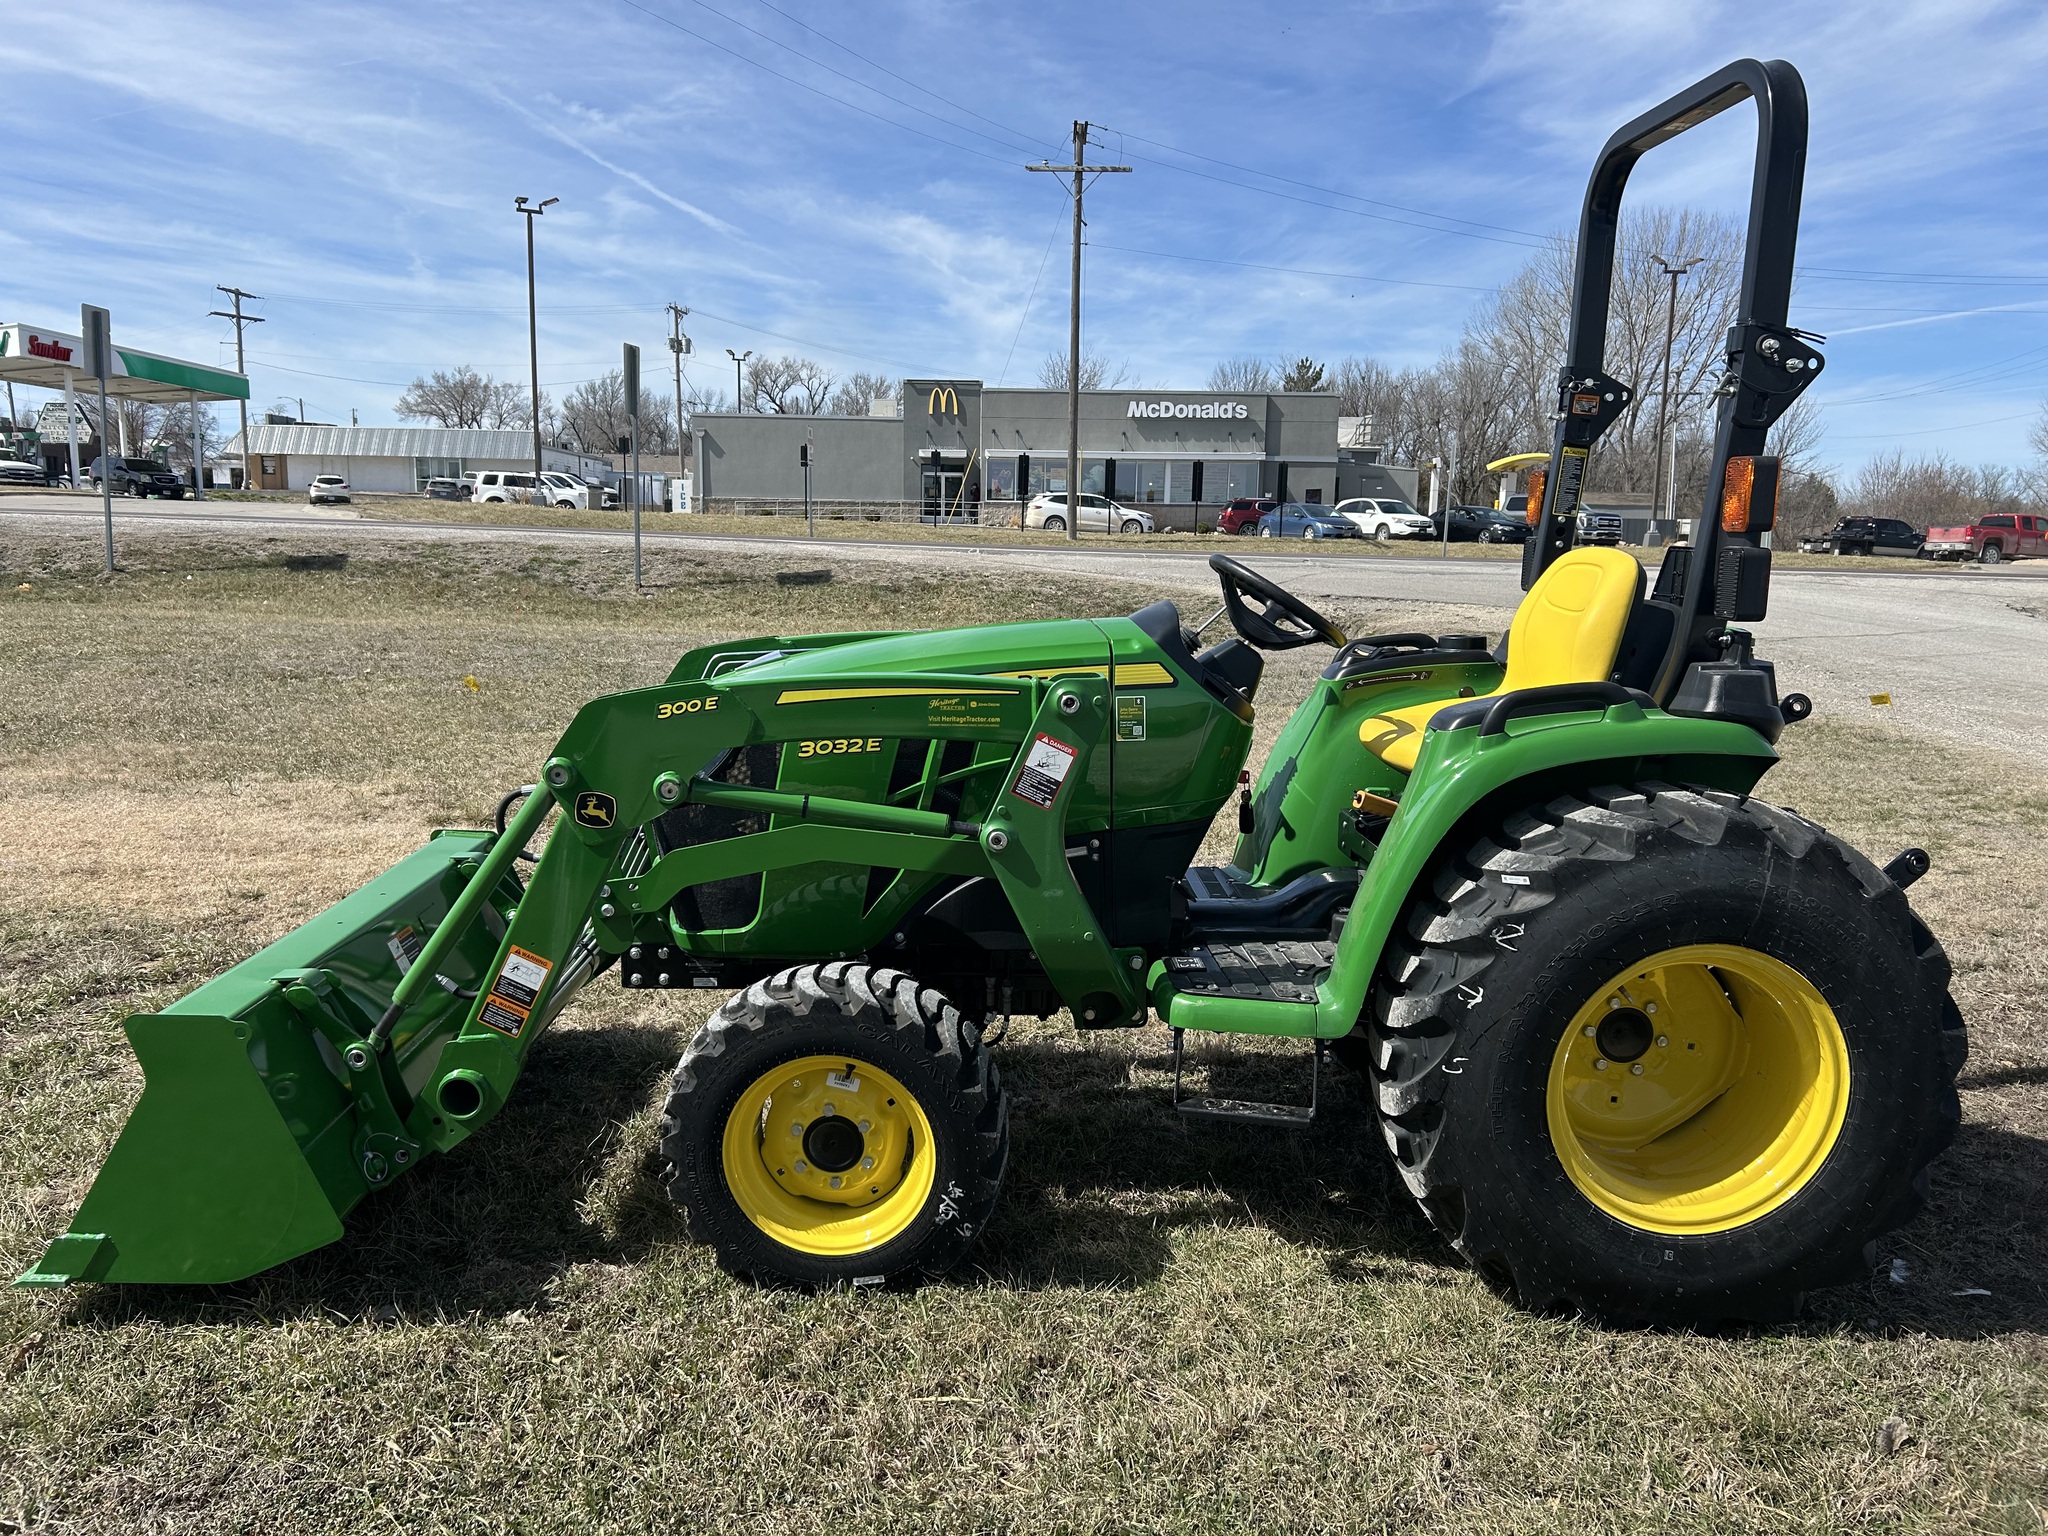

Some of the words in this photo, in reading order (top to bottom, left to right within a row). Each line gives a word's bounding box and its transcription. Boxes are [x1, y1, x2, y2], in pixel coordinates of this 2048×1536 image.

[28, 335, 73, 361] Sinclair
[1126, 401, 1247, 418] McDonald's
[929, 698, 960, 709] Heritage
[1049, 740, 1073, 754] DANGER
[521, 951, 548, 967] WARNING
[498, 1001, 525, 1016] WARNING
[856, 1022, 967, 1115] GALAXY
